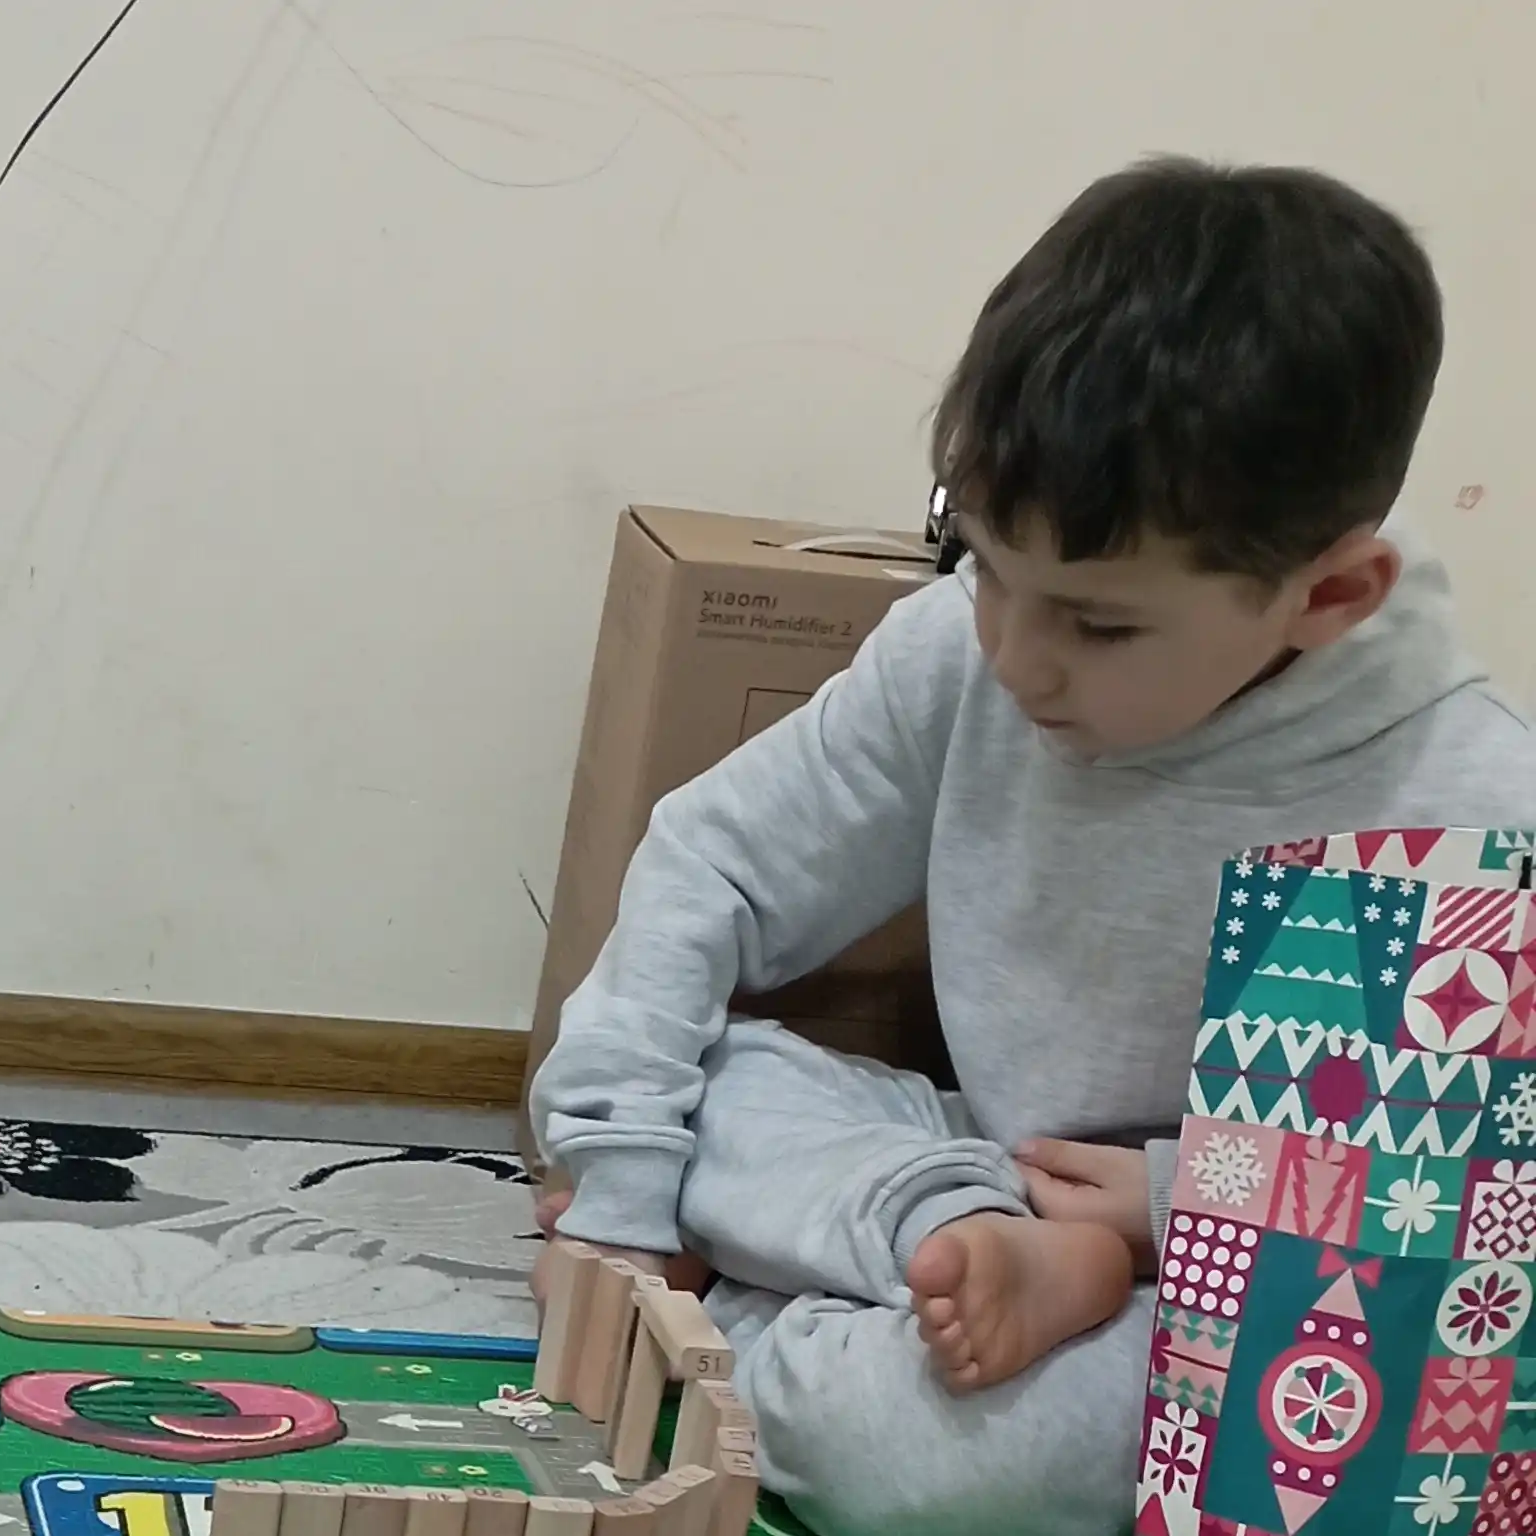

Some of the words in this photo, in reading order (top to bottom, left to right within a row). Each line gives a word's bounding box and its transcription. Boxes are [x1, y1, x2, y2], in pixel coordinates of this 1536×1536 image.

[697, 608, 746, 627] Smart
[750, 614, 837, 635] Humidifier
[840, 621, 853, 636] 2
[696, 1355, 720, 1373] 51
